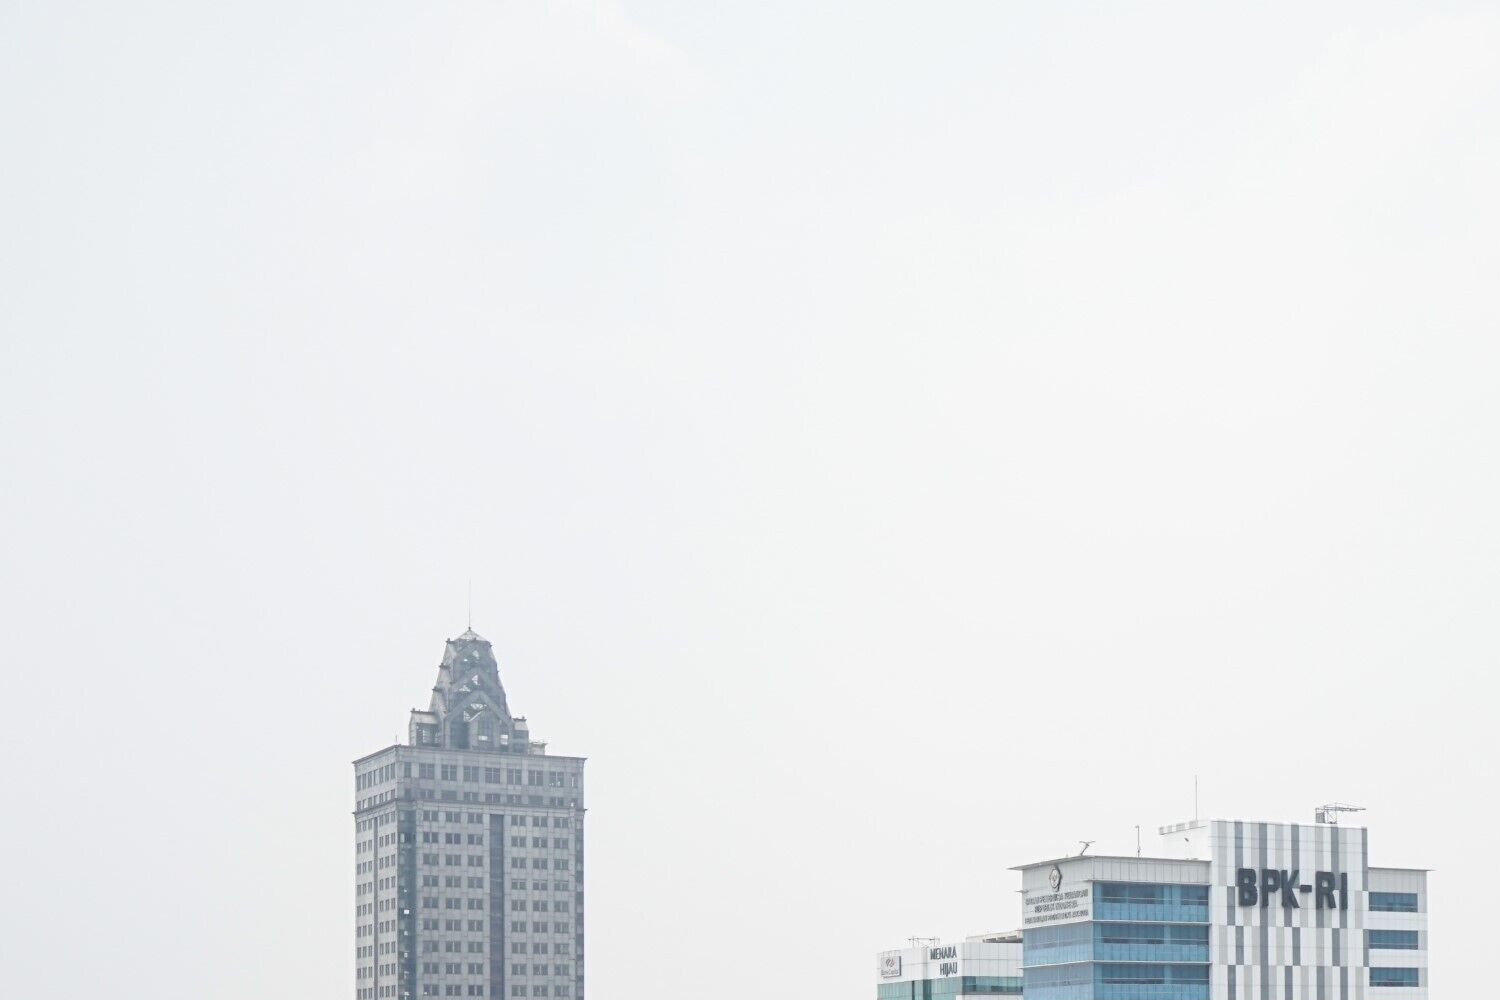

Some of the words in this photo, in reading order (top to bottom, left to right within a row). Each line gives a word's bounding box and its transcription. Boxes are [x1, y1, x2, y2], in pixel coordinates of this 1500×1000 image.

[1238, 867, 1348, 910] BPK-RI
[930, 946, 957, 961] MENARA
[940, 962, 958, 977] HIJAU
